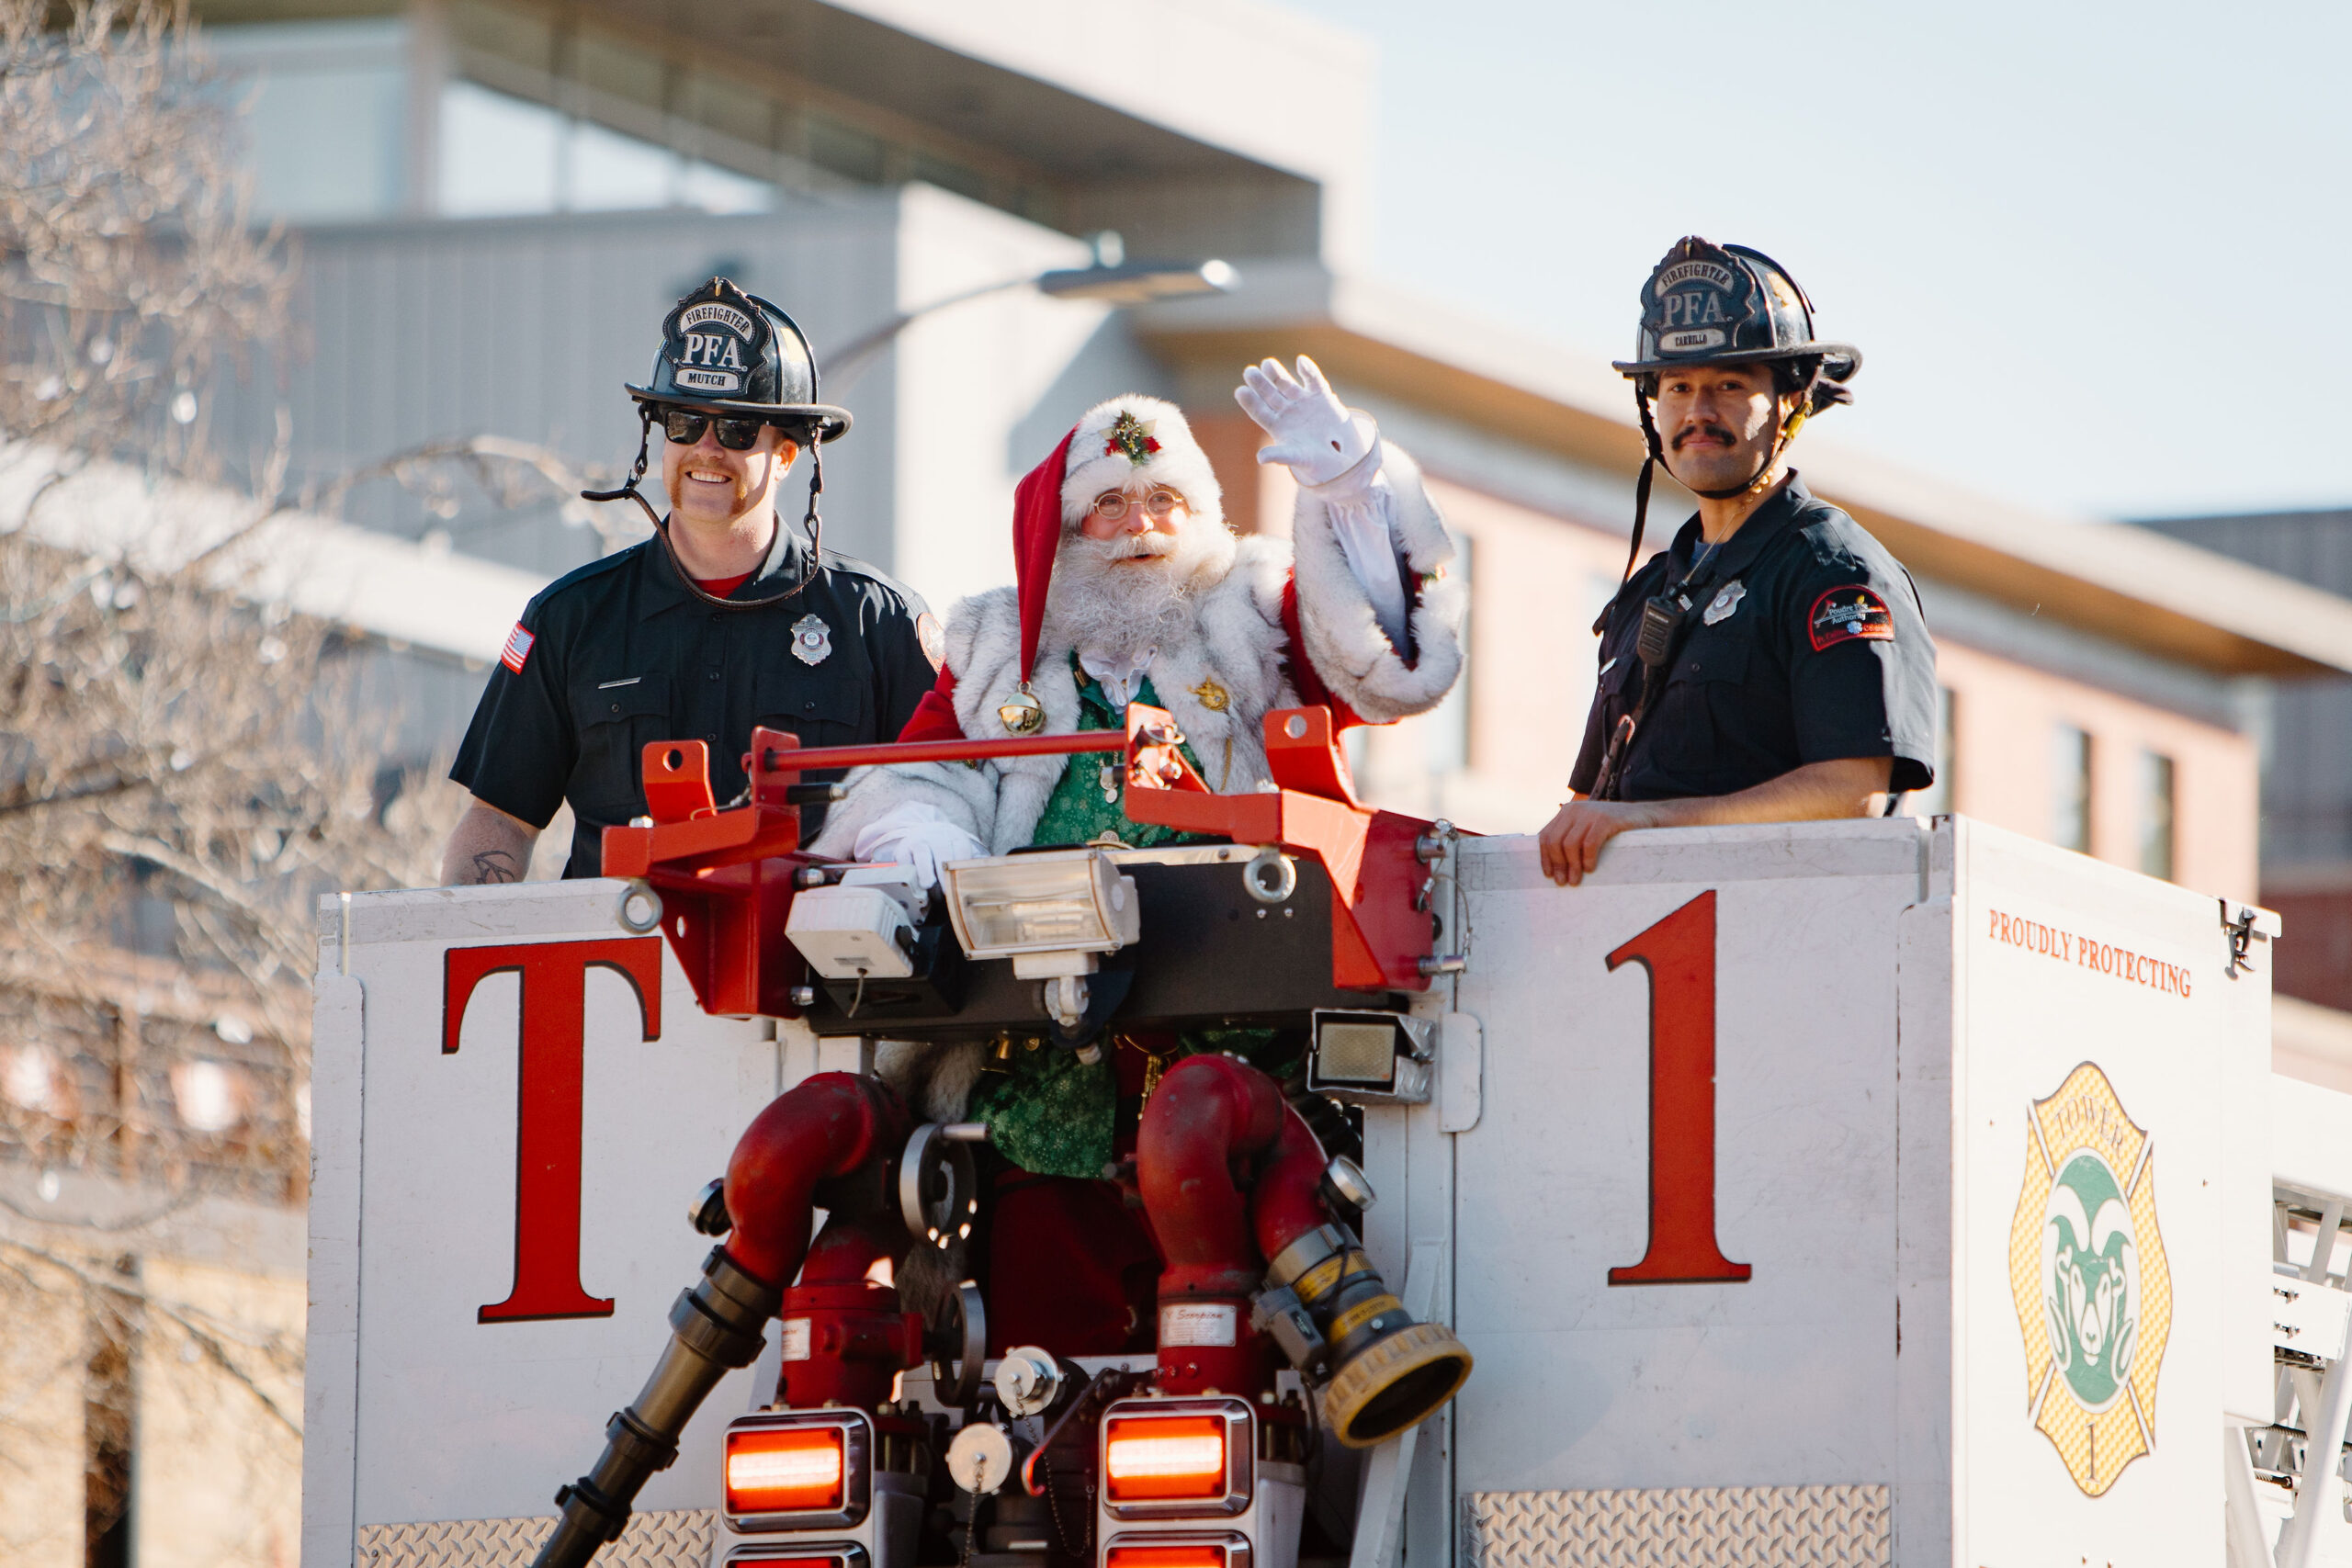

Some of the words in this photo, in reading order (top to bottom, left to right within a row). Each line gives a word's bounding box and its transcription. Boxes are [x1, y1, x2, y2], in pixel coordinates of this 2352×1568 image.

[1661, 264, 1730, 288] FIREFIGHTER
[685, 307, 750, 333] FIREFIGHTER
[1661, 291, 1725, 328] PFA
[682, 333, 742, 368] PFA
[687, 372, 726, 386] MUTCH
[1988, 908, 2073, 962] PROUDLY
[2077, 936, 2191, 998] PROTECTING
[442, 936, 662, 1325] T
[1604, 889, 1752, 1287] 1
[2054, 1094, 2122, 1161] TOWER
